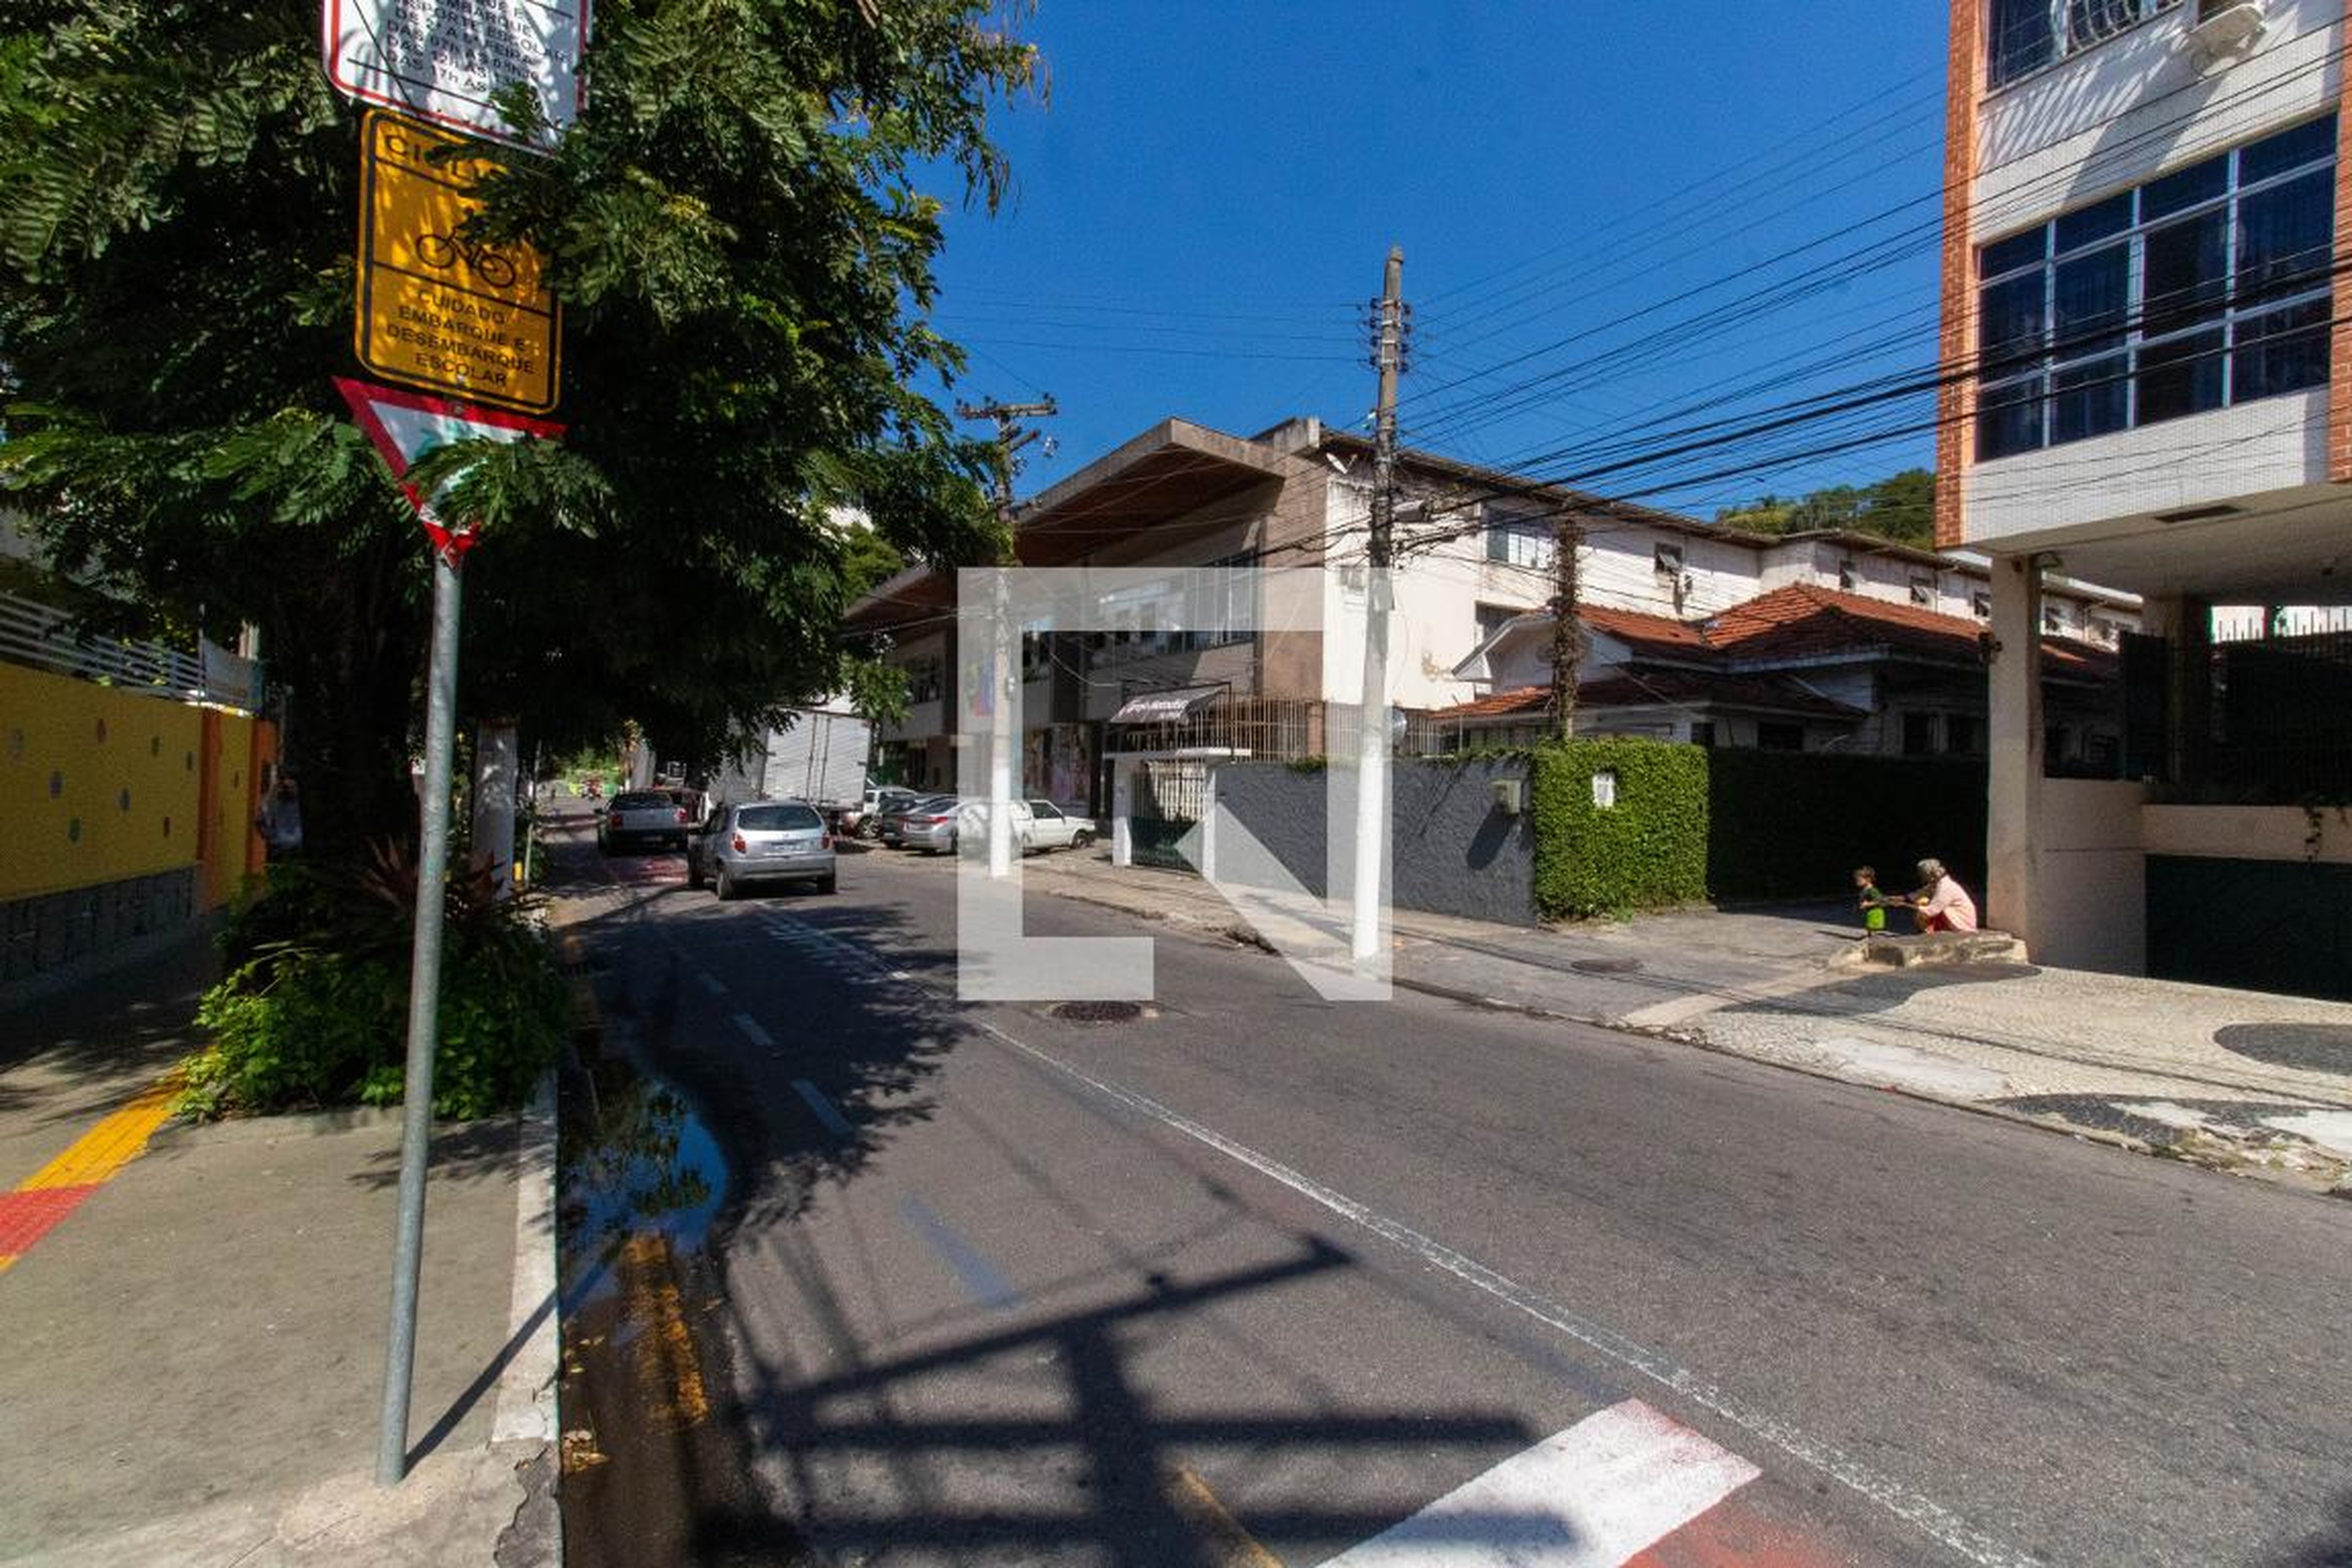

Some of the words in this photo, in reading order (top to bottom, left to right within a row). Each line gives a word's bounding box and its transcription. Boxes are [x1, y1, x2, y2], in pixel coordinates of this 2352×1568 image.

[399, 306, 507, 345] EMBARQUE
[418, 290, 505, 324] CUIDADO
[387, 323, 535, 374] DESEMBARQUE
[415, 352, 507, 387] ESCOLAR
